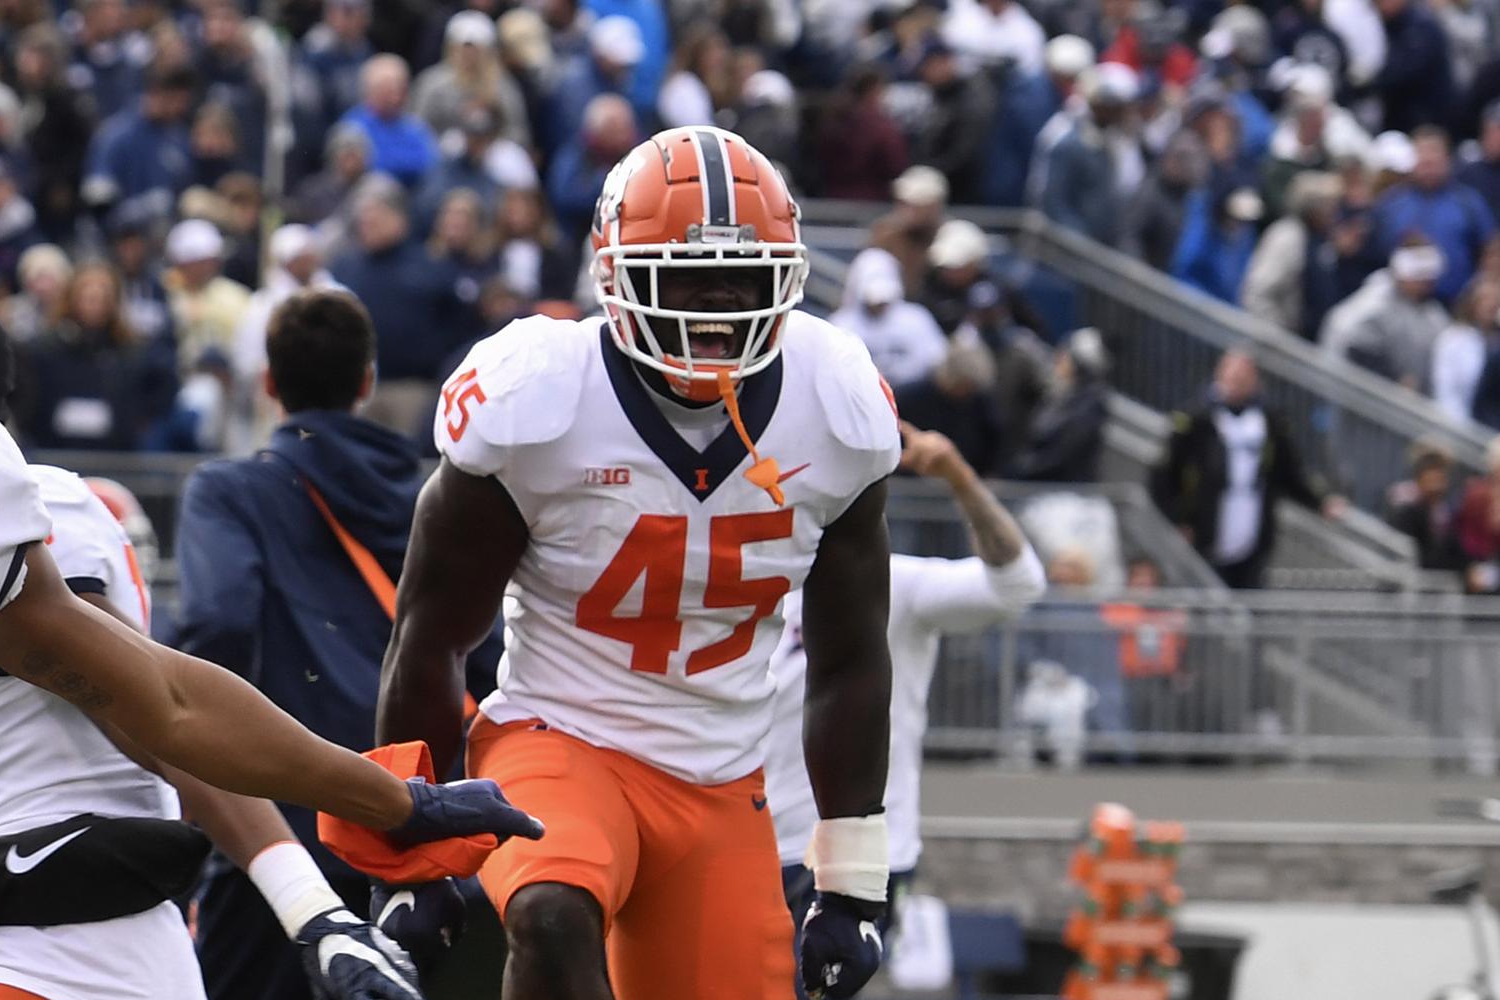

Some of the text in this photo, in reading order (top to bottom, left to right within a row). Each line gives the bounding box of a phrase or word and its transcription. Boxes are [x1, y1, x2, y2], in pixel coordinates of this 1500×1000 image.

[443, 367, 487, 443] 45
[694, 469, 709, 491] I
[575, 508, 794, 676] 45
